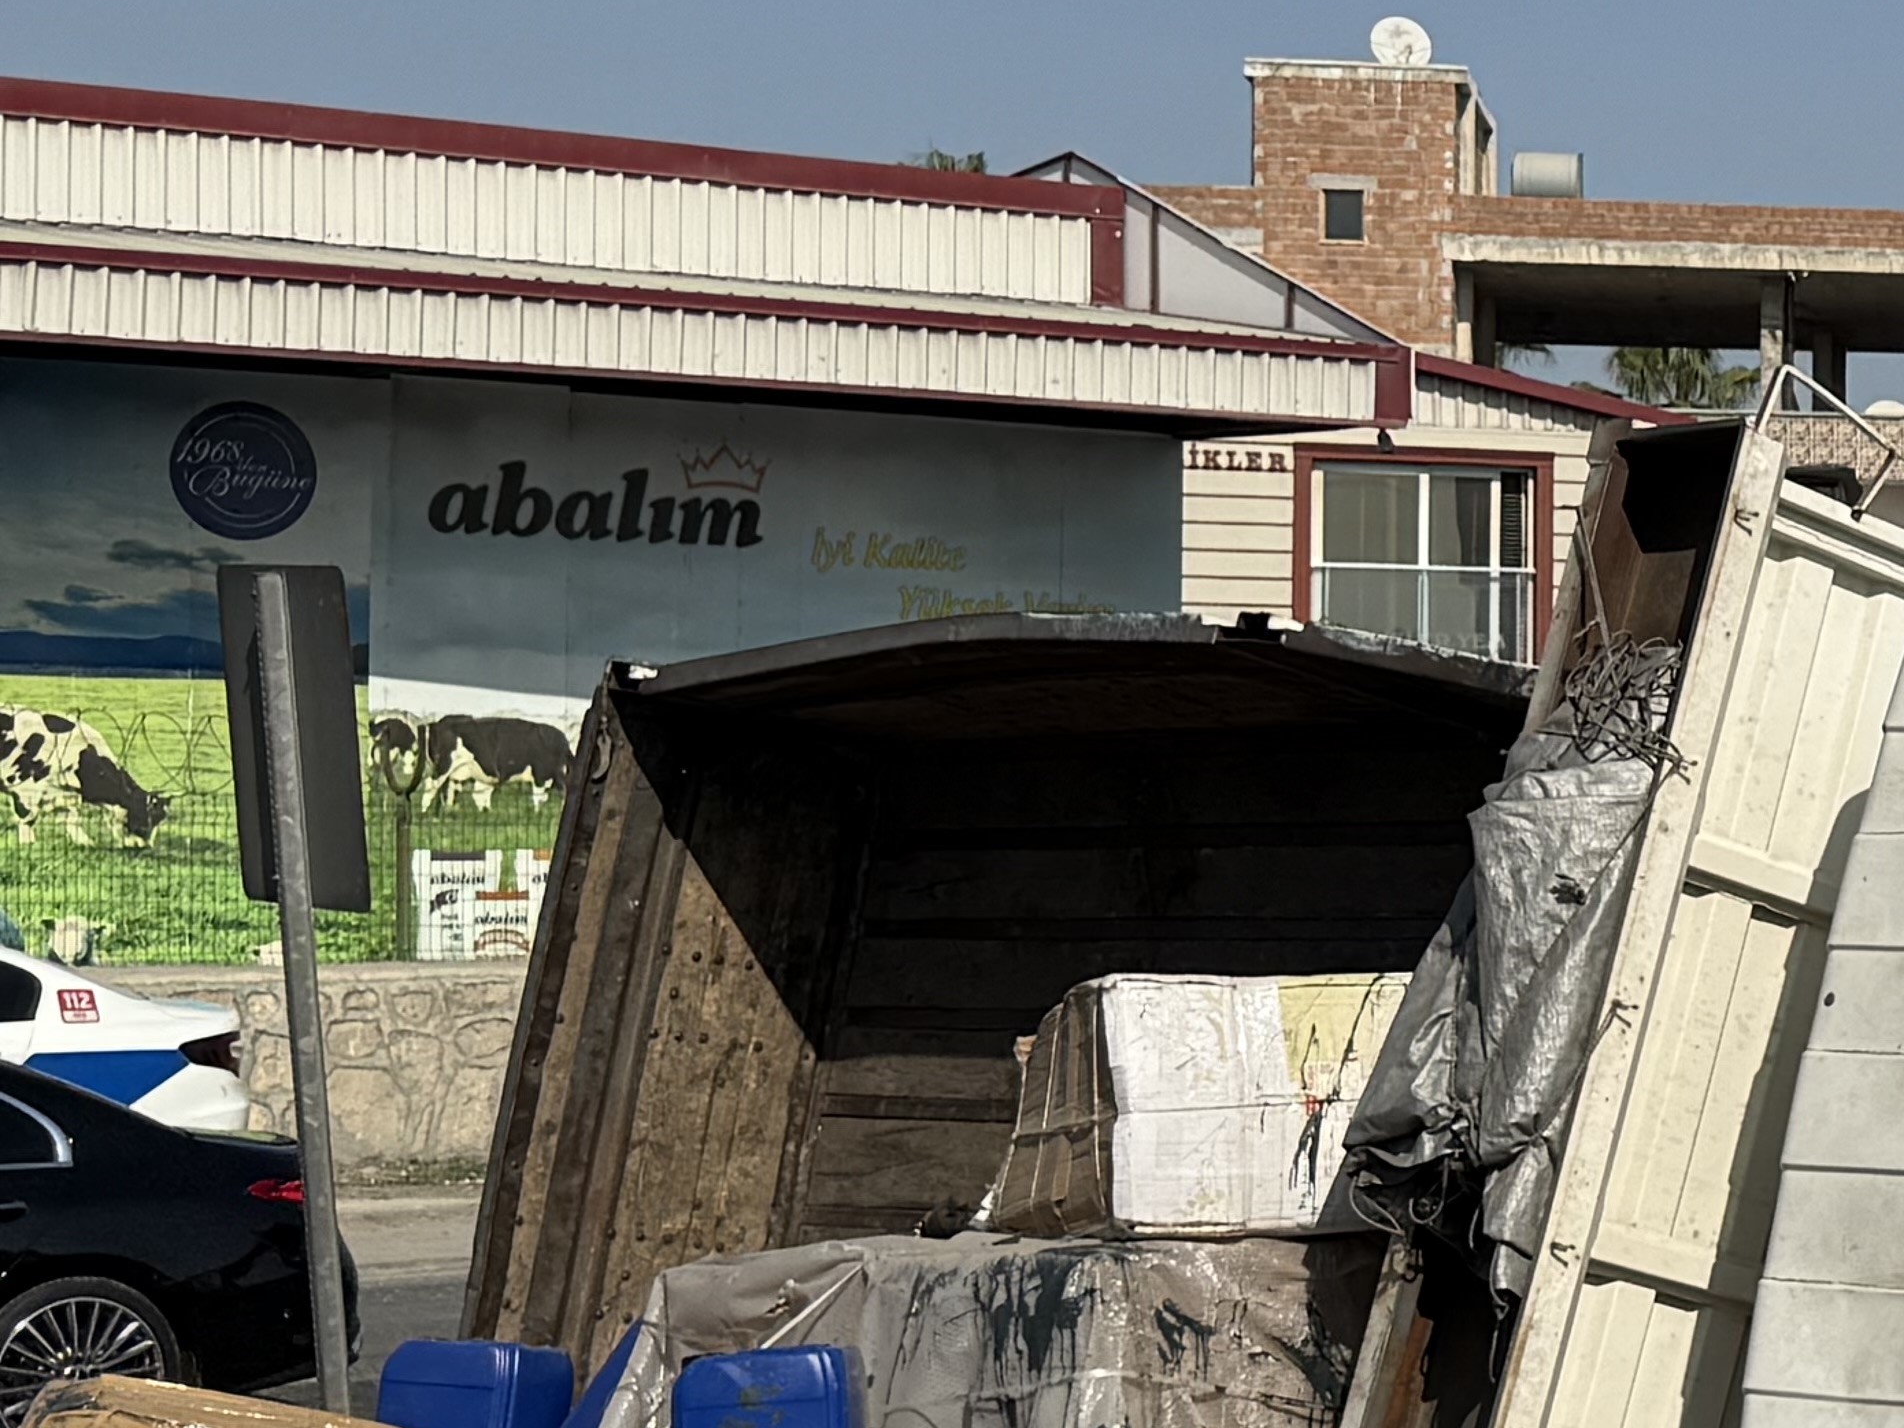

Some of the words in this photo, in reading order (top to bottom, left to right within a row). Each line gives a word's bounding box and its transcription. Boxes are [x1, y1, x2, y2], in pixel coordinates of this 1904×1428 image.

[1188, 441, 1288, 471] İKLER
[428, 460, 763, 548] abalım
[864, 533, 967, 570] Kalite
[63, 992, 93, 1009] 112
